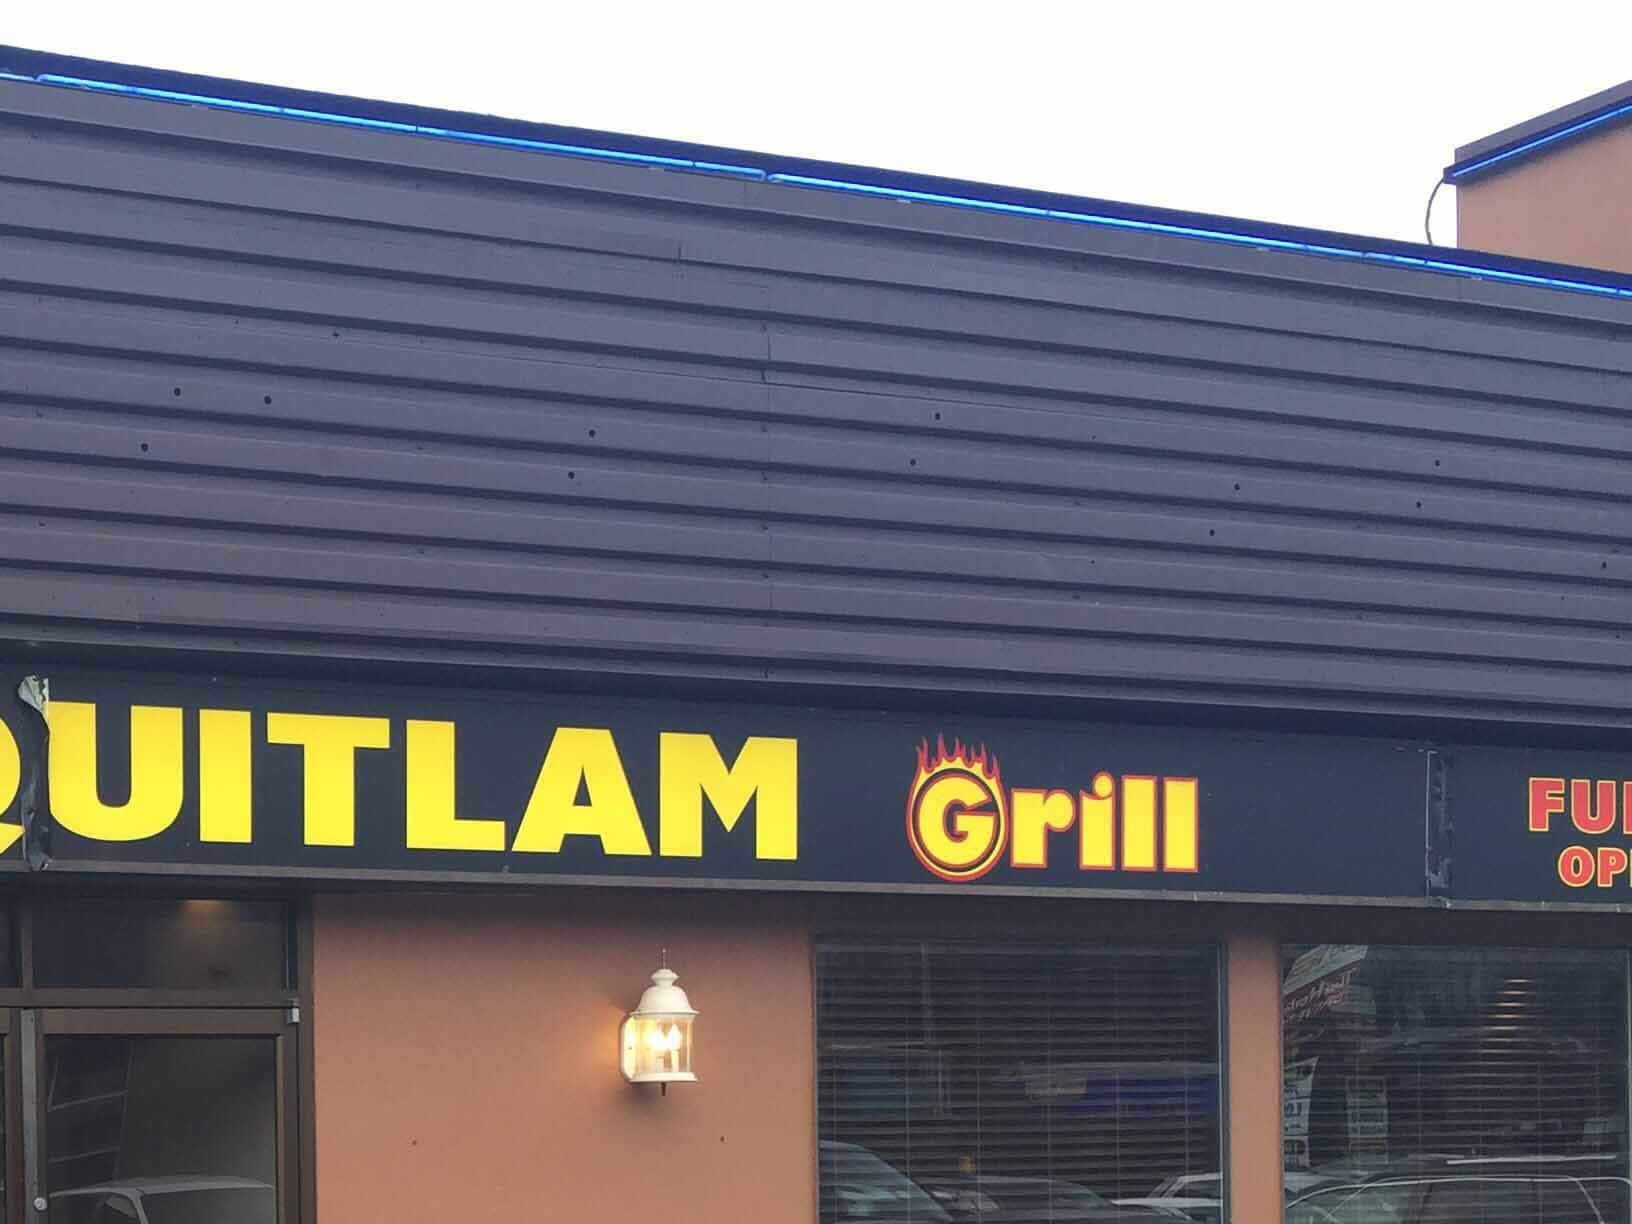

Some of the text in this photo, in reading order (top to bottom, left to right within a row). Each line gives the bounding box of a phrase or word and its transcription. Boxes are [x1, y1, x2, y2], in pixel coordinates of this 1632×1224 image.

[908, 758, 1199, 882] Grill
[1529, 777, 1632, 834] FU
[1558, 846, 1632, 887] OP
